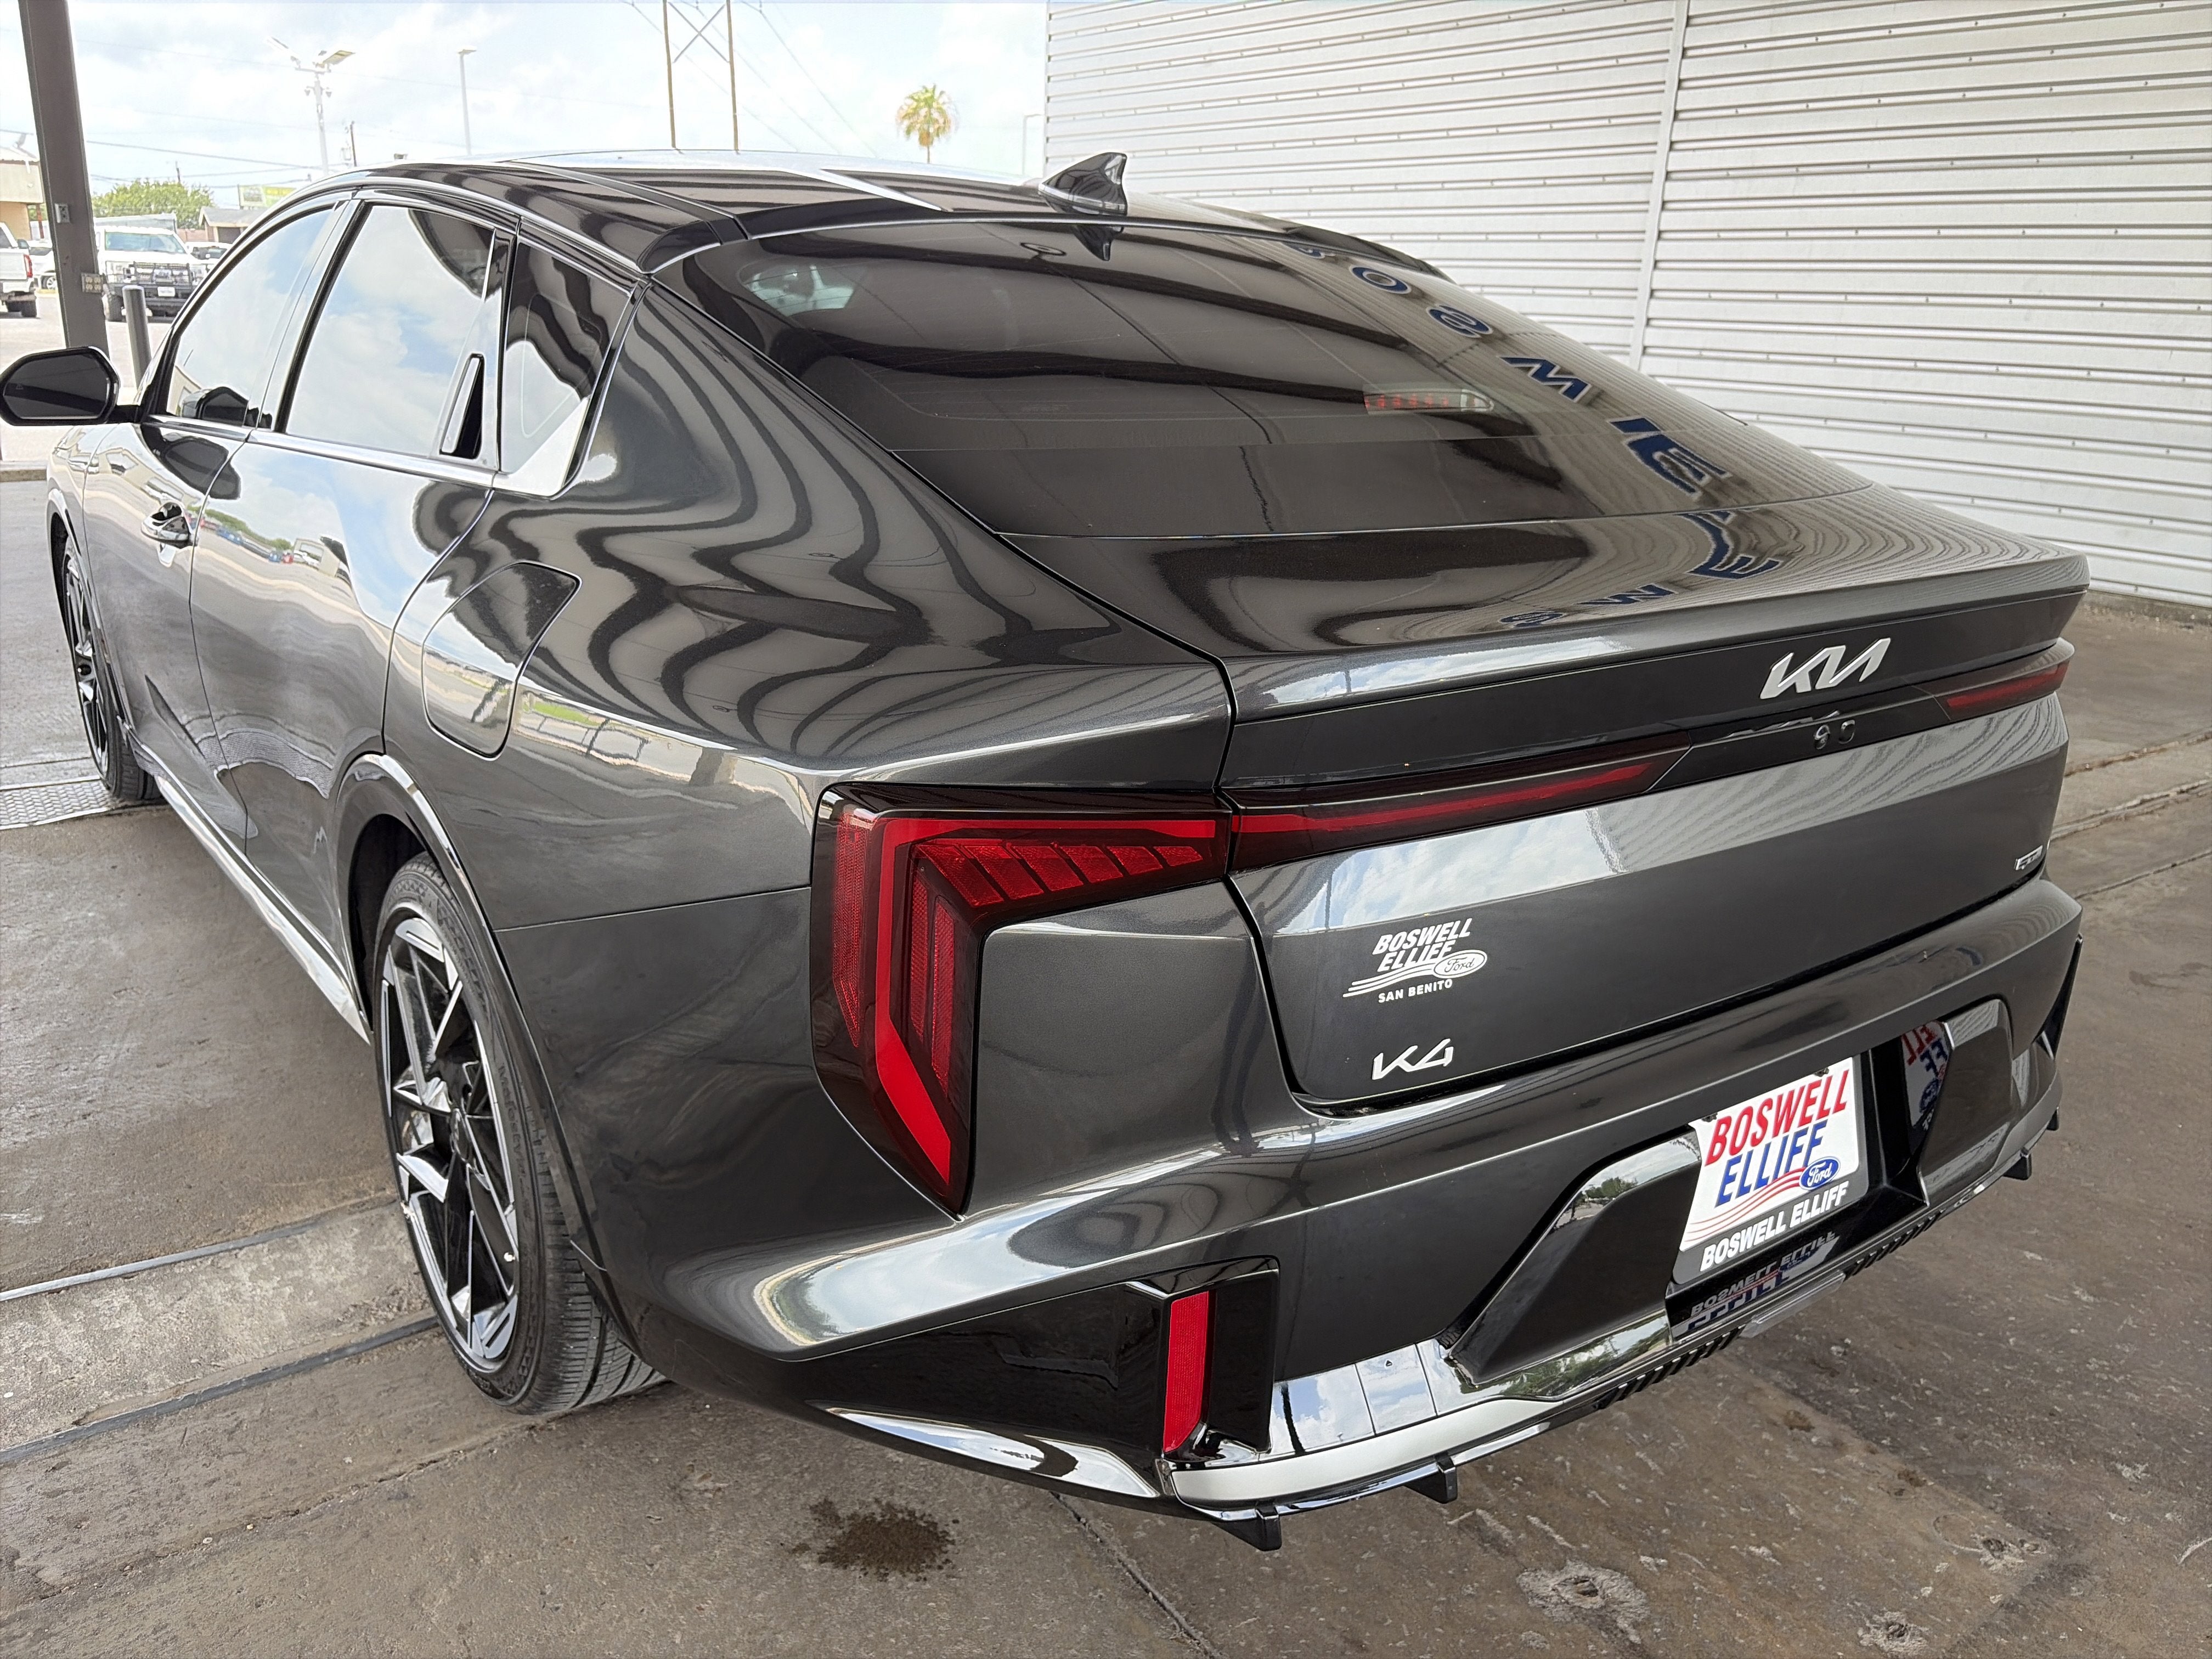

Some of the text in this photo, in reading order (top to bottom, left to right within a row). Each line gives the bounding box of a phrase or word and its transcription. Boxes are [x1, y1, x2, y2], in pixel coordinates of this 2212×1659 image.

[1759, 637, 1891, 699] KIA
[1372, 918, 1473, 955] BOSWELL
[1377, 940, 1456, 972] ELLIFF
[1444, 956, 1475, 974] Ford
[1378, 979, 1453, 1003] SAN BENITO
[1372, 1038, 1454, 1080] K4
[1705, 1069, 1850, 1166] BOSWELL
[1714, 1119, 1828, 1207] ELLIFF
[1808, 1165, 1833, 1184] Ford
[1700, 1181, 1849, 1272] BOSWELL ELLIFF
